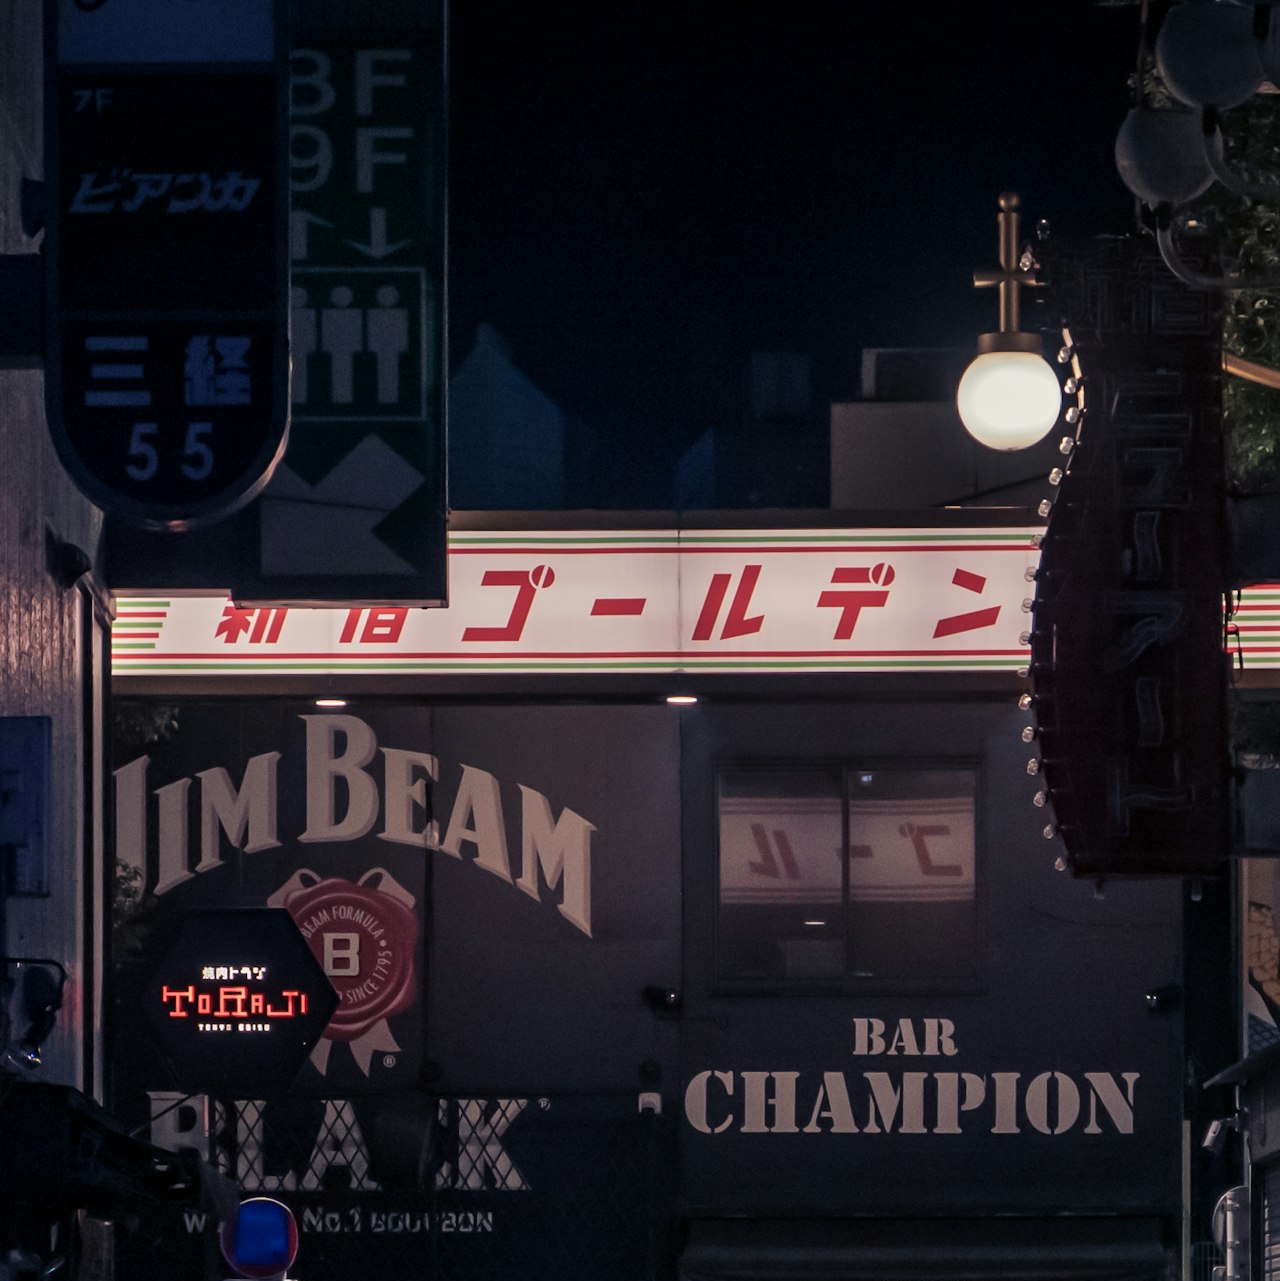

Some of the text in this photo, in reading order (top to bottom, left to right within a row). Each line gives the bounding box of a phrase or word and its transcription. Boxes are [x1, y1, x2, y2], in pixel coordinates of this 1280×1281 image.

[114, 713, 598, 939] JIM BEAM
[331, 904, 386, 940] FORMULA
[322, 931, 361, 978] B
[345, 949, 394, 1005] SINCE 1795
[162, 985, 308, 1017] TORAJI
[852, 1017, 959, 1056] BAR
[684, 1068, 1142, 1136] CHAMPION
